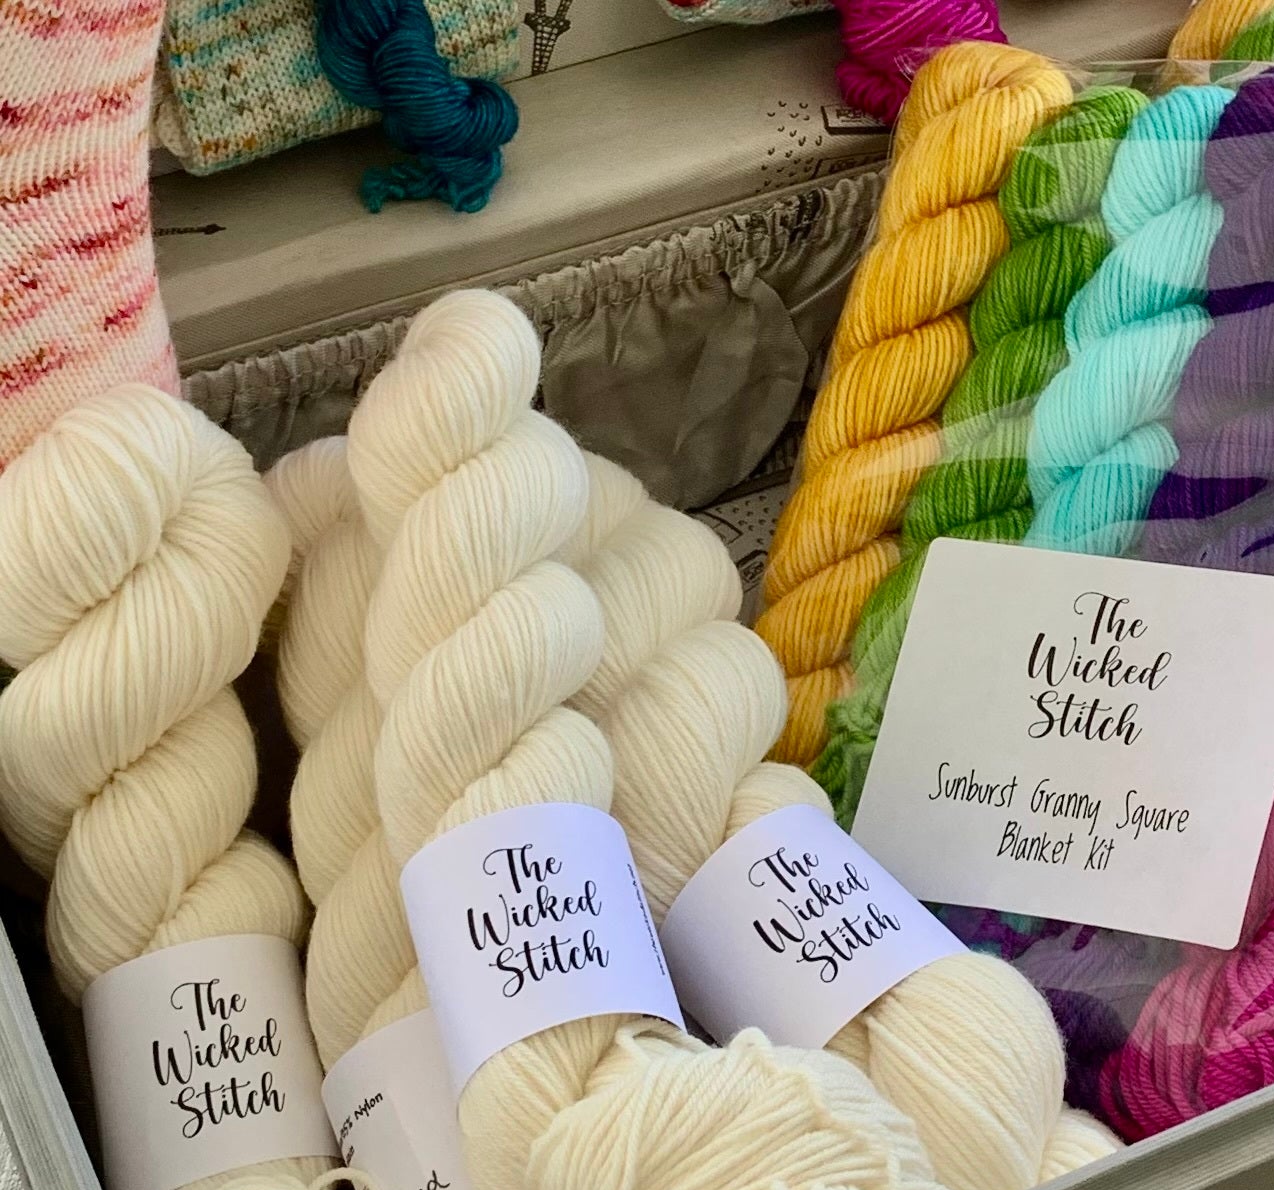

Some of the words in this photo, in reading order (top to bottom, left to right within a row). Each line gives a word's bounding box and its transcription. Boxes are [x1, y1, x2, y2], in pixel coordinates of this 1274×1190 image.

[1073, 592, 1148, 645] The
[1028, 633, 1172, 691] Wicked
[1028, 690, 1142, 745] Stitch
[929, 762, 1018, 808] Sunburst
[1031, 779, 1101, 836] Granny
[1116, 790, 1189, 839] Square
[483, 844, 562, 894] The
[748, 847, 819, 892] The
[997, 821, 1074, 864] Blanket
[1084, 832, 1115, 870] Kit
[467, 878, 602, 951] Wicked
[753, 863, 869, 953] Wicked
[488, 930, 609, 997] Stitch
[796, 903, 901, 983] Stitch
[171, 979, 246, 1031] The
[152, 1015, 281, 1086] Wicked
[170, 1072, 285, 1138] Stitch
[354, 1093, 383, 1120] Nylon
